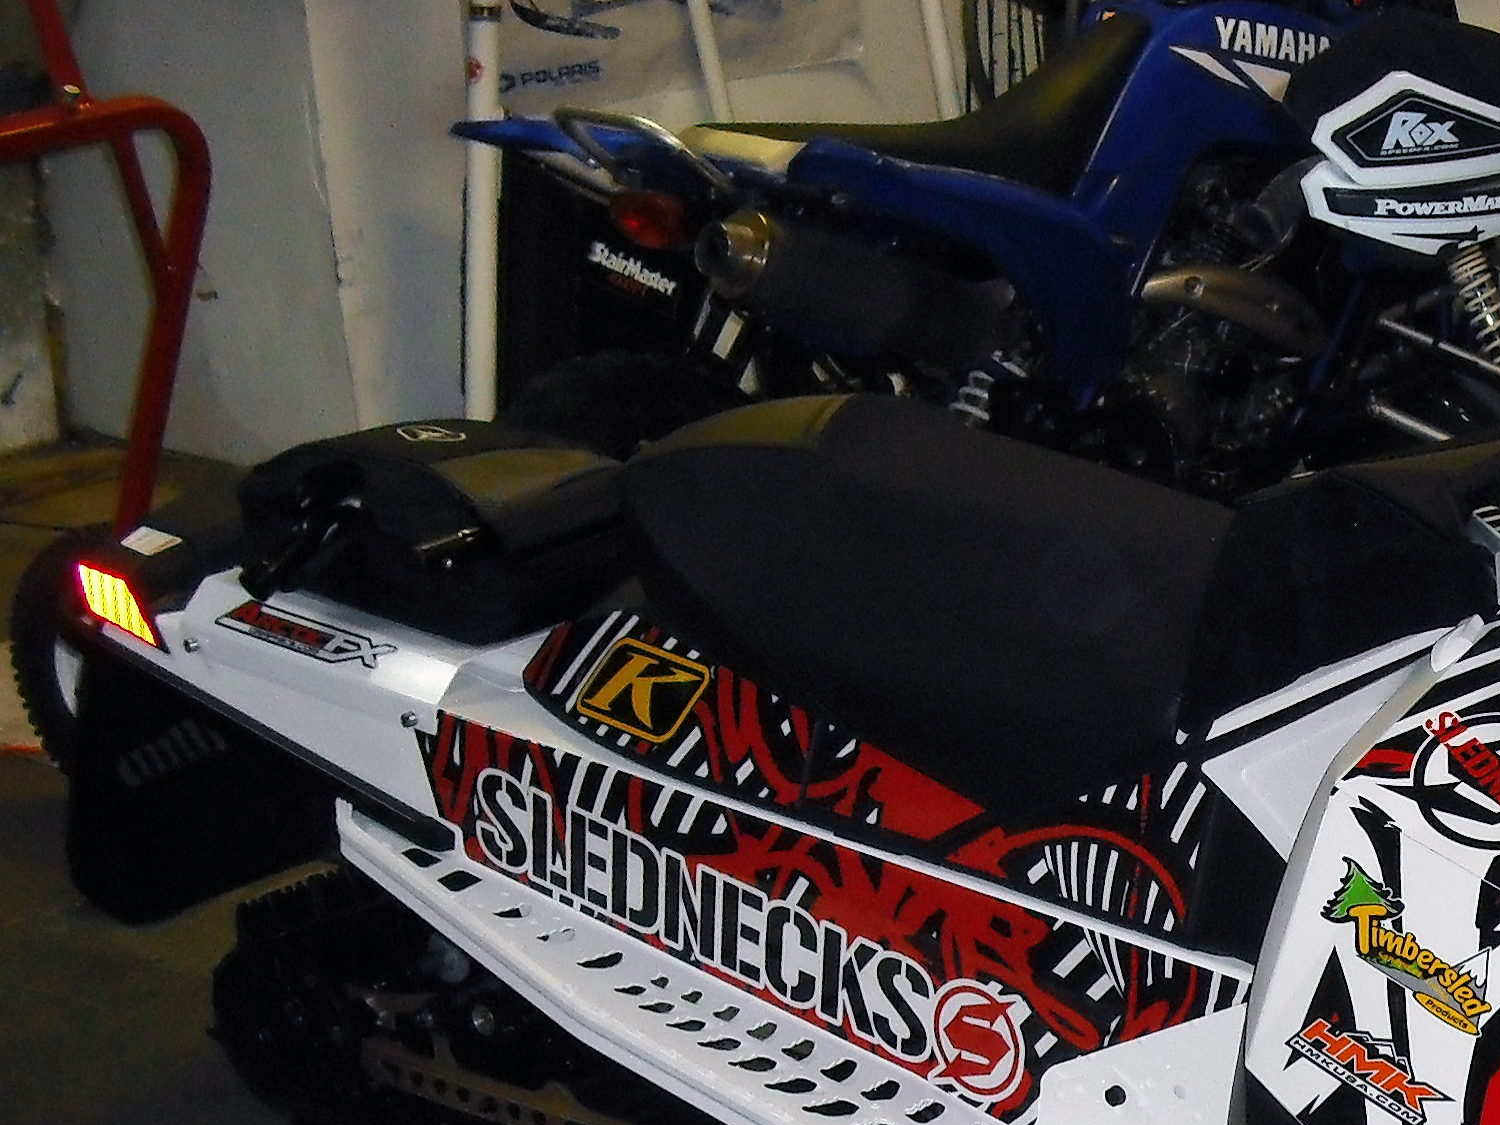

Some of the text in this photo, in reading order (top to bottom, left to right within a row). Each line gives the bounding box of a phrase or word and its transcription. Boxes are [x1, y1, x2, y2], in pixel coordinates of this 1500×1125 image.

[520, 60, 600, 87] POLARIS
[1215, 15, 1331, 64] YAMAHA
[587, 241, 677, 296] StairMaster
[476, 767, 936, 1062] SLEDNECKS
[1349, 904, 1492, 1018] Timbersled
[1294, 1039, 1420, 1124] HMKUBA.COM
[1301, 1018, 1440, 1112] HMK
